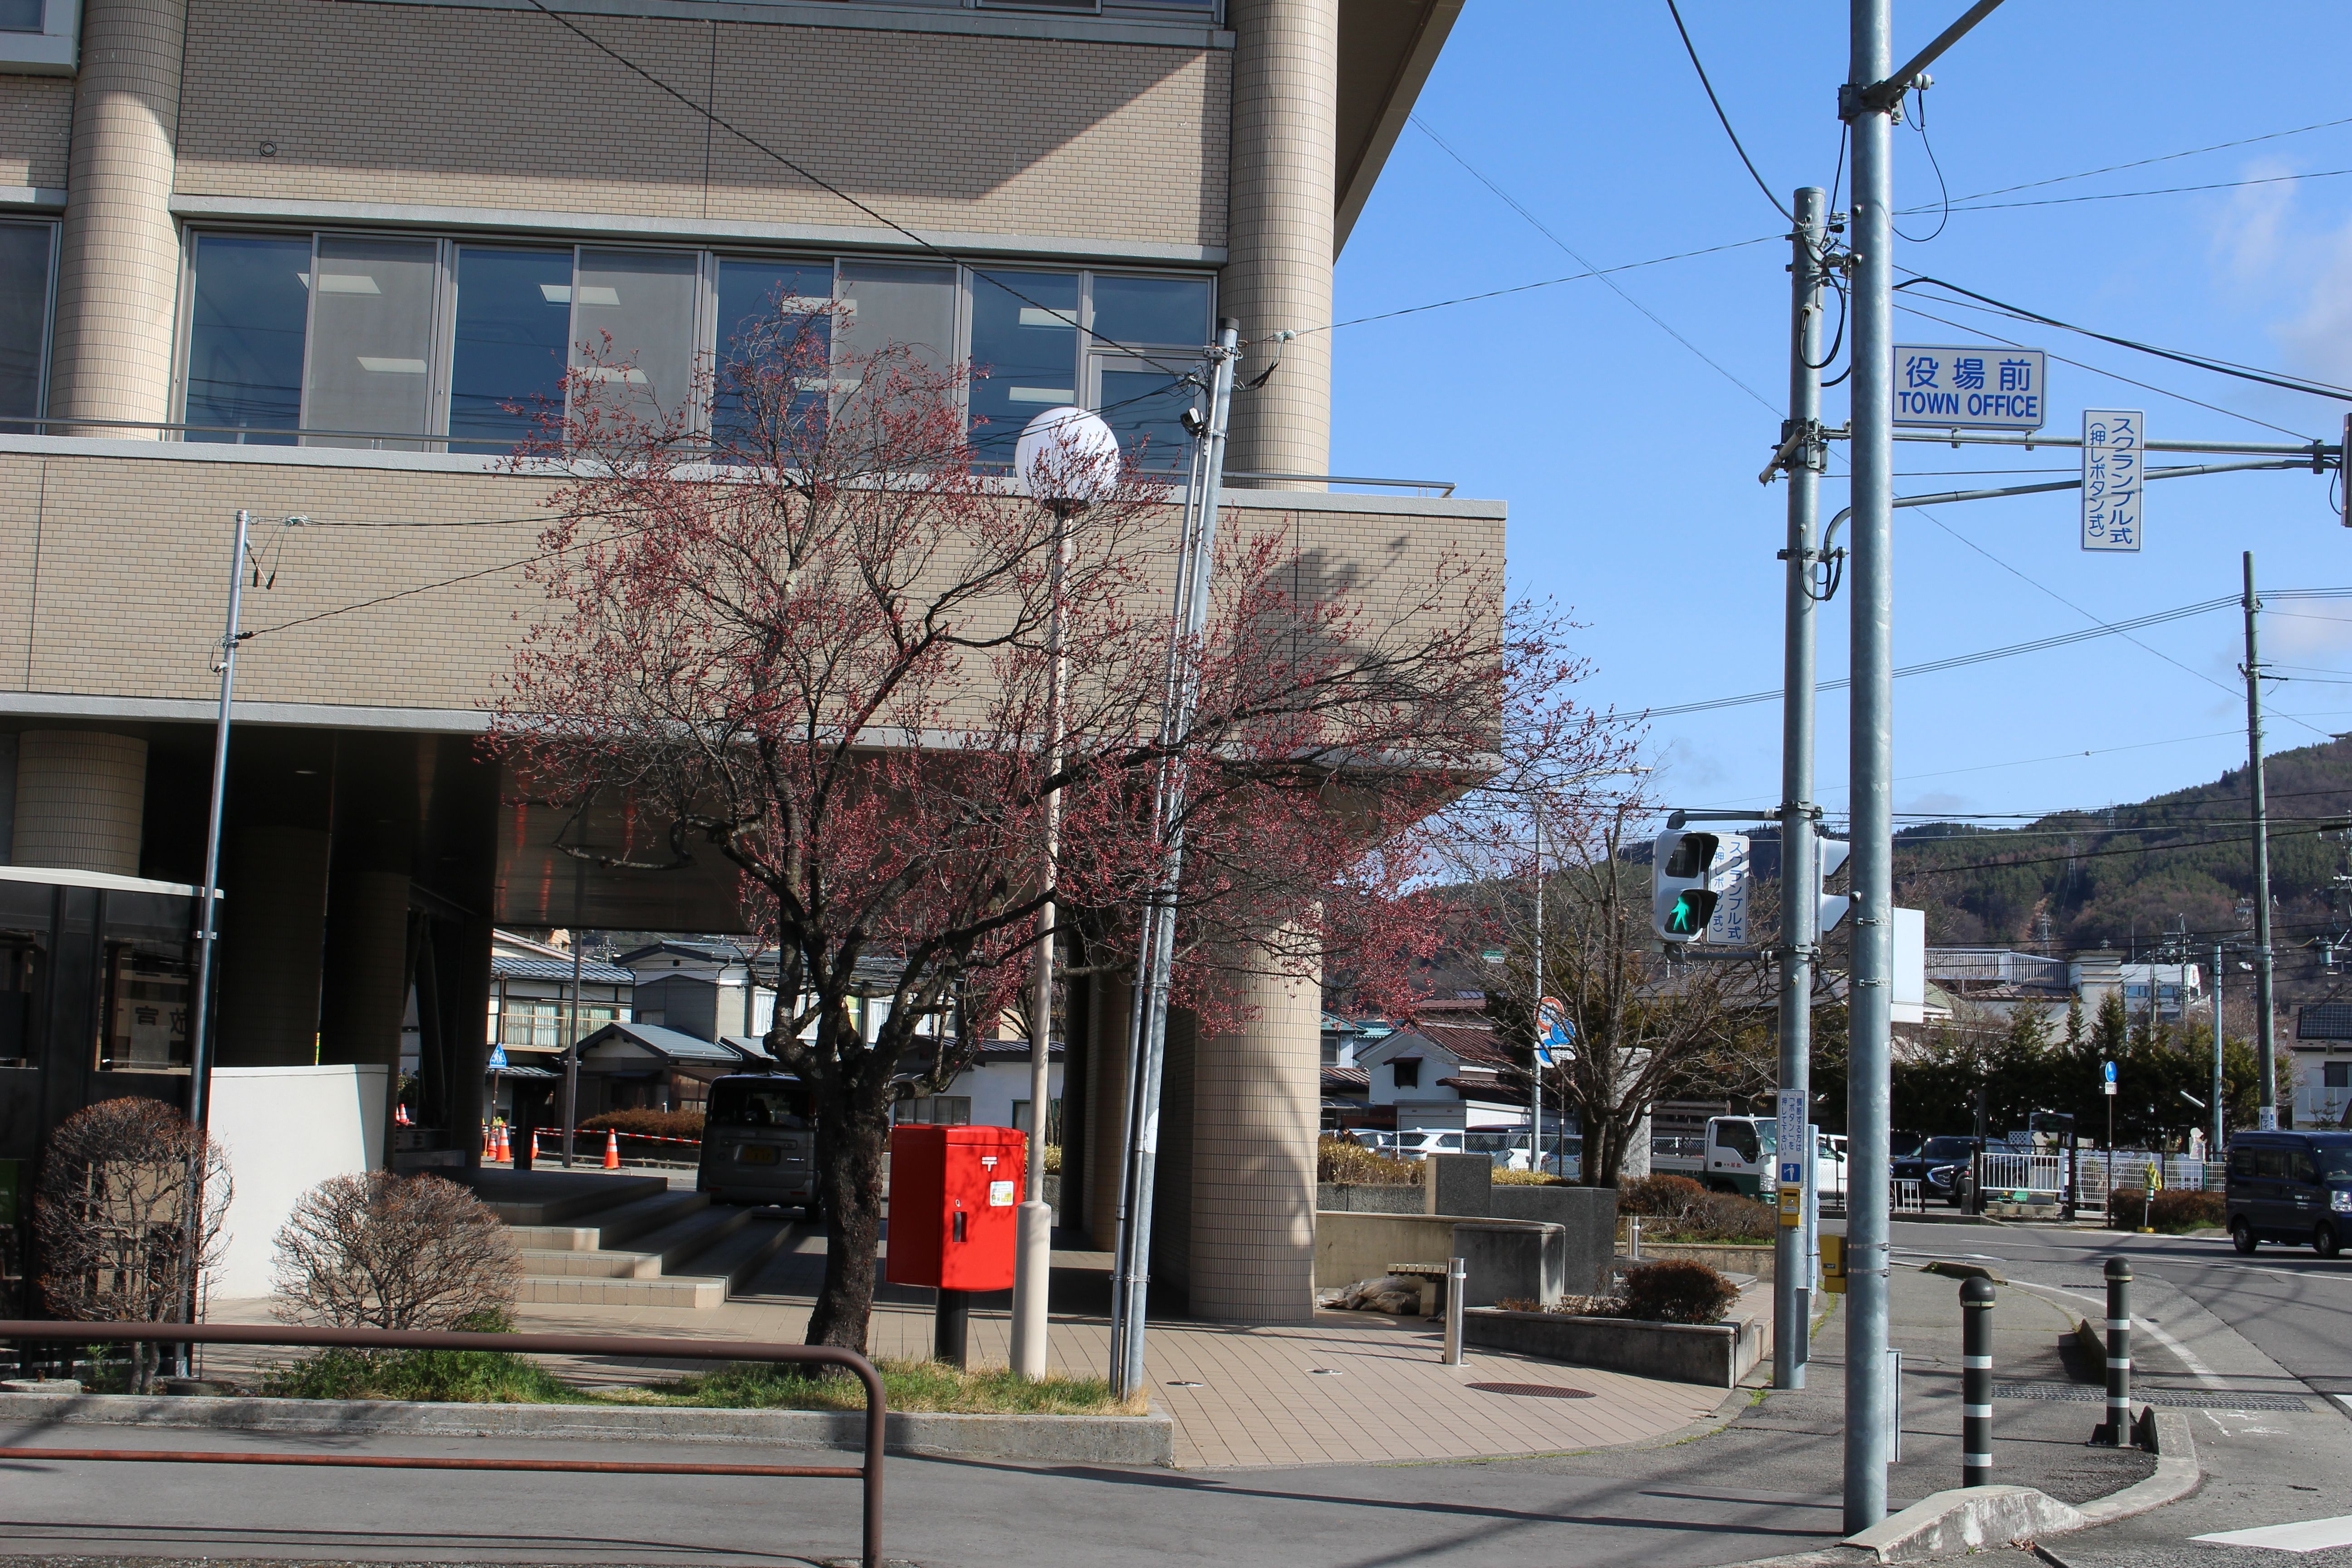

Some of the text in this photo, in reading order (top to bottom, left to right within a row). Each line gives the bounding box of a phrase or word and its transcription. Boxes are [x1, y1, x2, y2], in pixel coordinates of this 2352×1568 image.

[1898, 391, 2038, 418] TOWN OFFICE
[1906, 356, 2032, 392] 役場前
[2109, 417, 2135, 545] スクランブル式
[1728, 841, 1743, 940] スクランブル式
